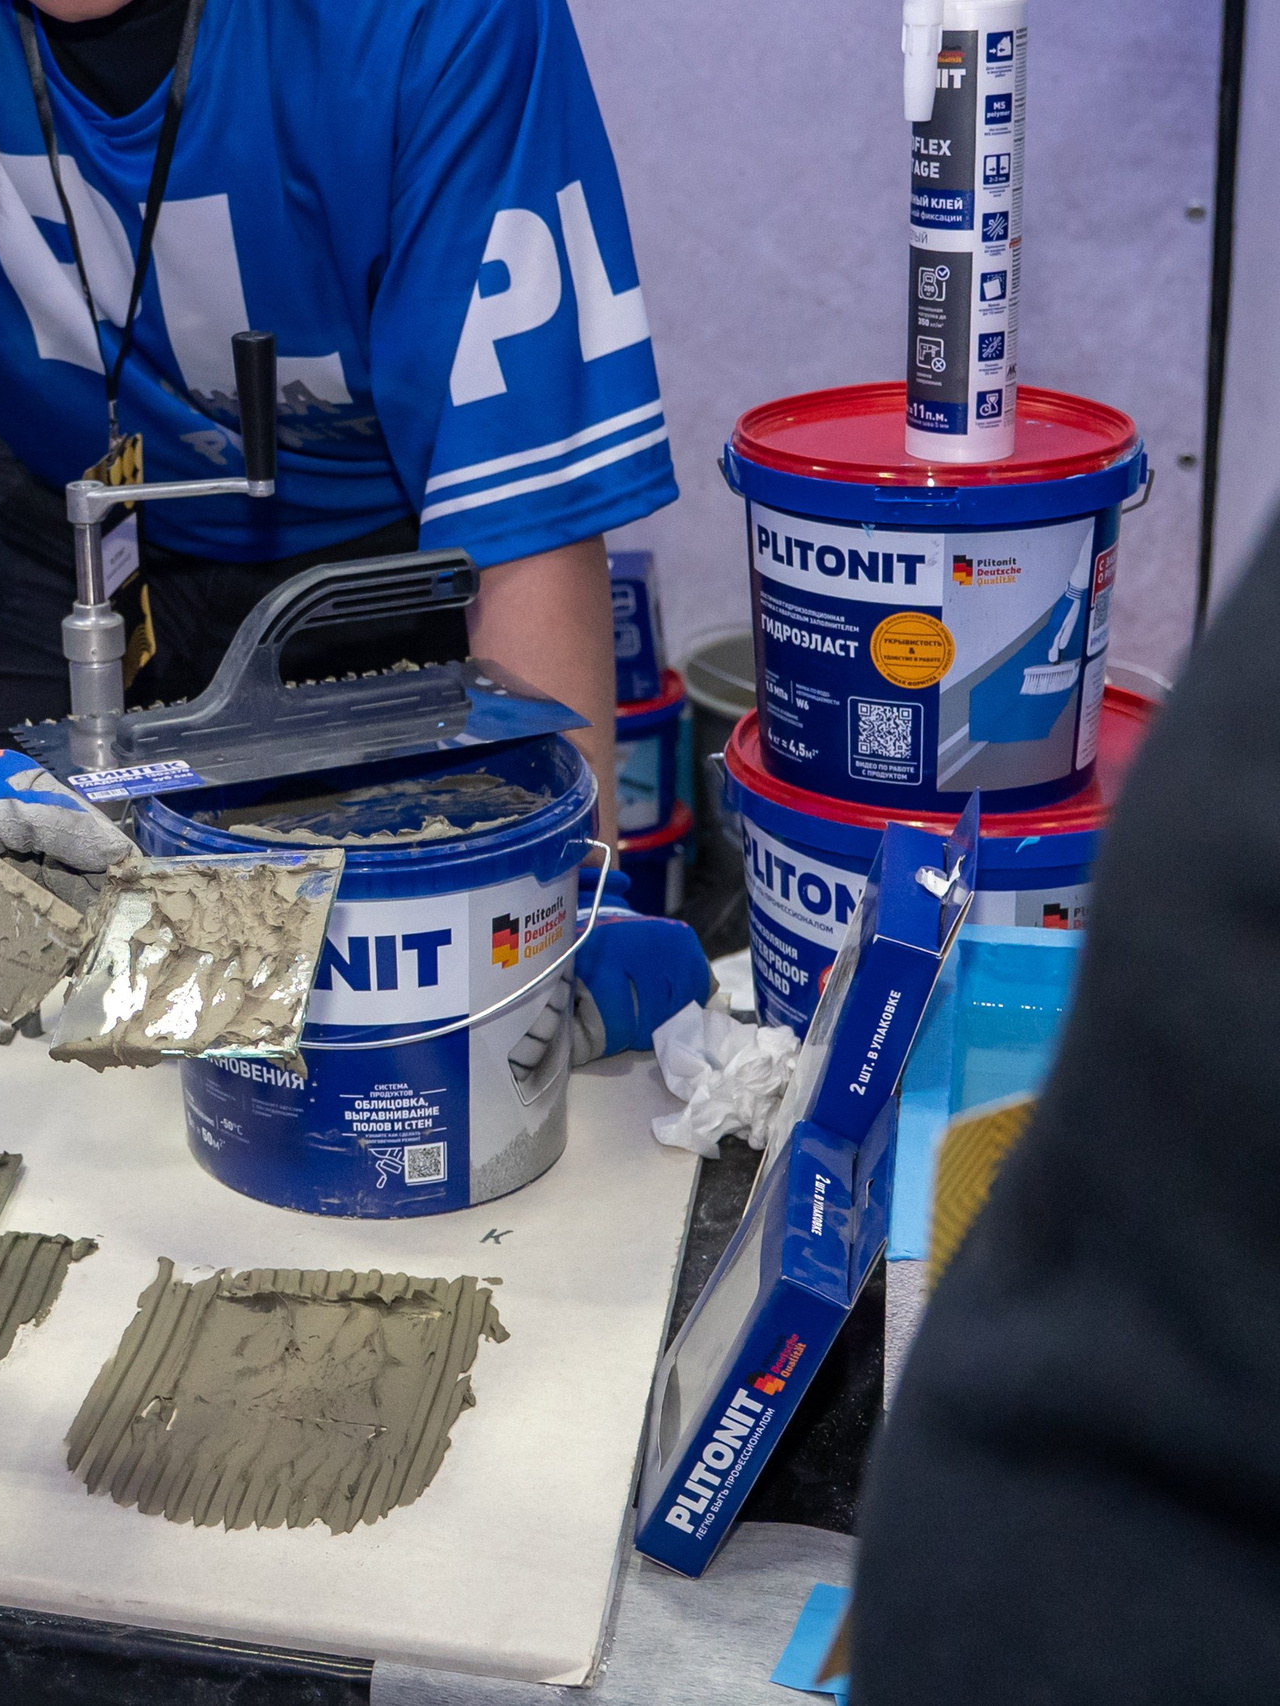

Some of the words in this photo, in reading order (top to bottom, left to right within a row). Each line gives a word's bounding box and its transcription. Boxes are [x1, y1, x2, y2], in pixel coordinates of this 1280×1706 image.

[993, 101, 1006, 110] MS
[986, 110, 1010, 119] polymer
[931, 196, 963, 210] КЛЕЙ
[921, 210, 963, 223] фиксации
[757, 523, 926, 586] PLITONIT
[977, 556, 1017, 567] Plitonit
[977, 566, 1022, 576] Deutsche
[761, 613, 859, 658] ГИДРОЭЛАСТ
[884, 638, 943, 647] УКРЫВИСТОСТЬ
[796, 697, 809, 710] W6
[855, 760, 877, 770] ВИДЕО
[878, 763, 888, 771] ПО
[889, 765, 915, 773] РАБОТЕ
[867, 770, 908, 780] ПРОДУКТОМ
[524, 895, 563, 929] Plitonit
[524, 909, 567, 945] Deutsche
[870, 989, 901, 1050] УПАКОВКЕ
[867, 1051, 879, 1060] В
[207, 1057, 305, 1090] КНОВЕНИЯ
[858, 1062, 875, 1083] ШТ.
[374, 1083, 409, 1091] СИСТЕМА
[849, 1083, 866, 1096] 2
[369, 1090, 414, 1098] ПРОДУКТОВ
[354, 1097, 429, 1110] ОБЛИЦОВКА,
[344, 1106, 440, 1120] ВЫРАВНИВАНИЕ
[353, 1122, 392, 1132] ПОЛОВ
[394, 1121, 403, 1131] И
[404, 1119, 433, 1130] СТЕН
[815, 1173, 831, 1185] 2
[664, 1387, 764, 1534] PLITONIT
[695, 1513, 716, 1540] ЛЕГКО
[711, 1487, 729, 1512] БЫТЬ
[724, 1407, 776, 1489] ПРОФЕССИОНАЛОМ
